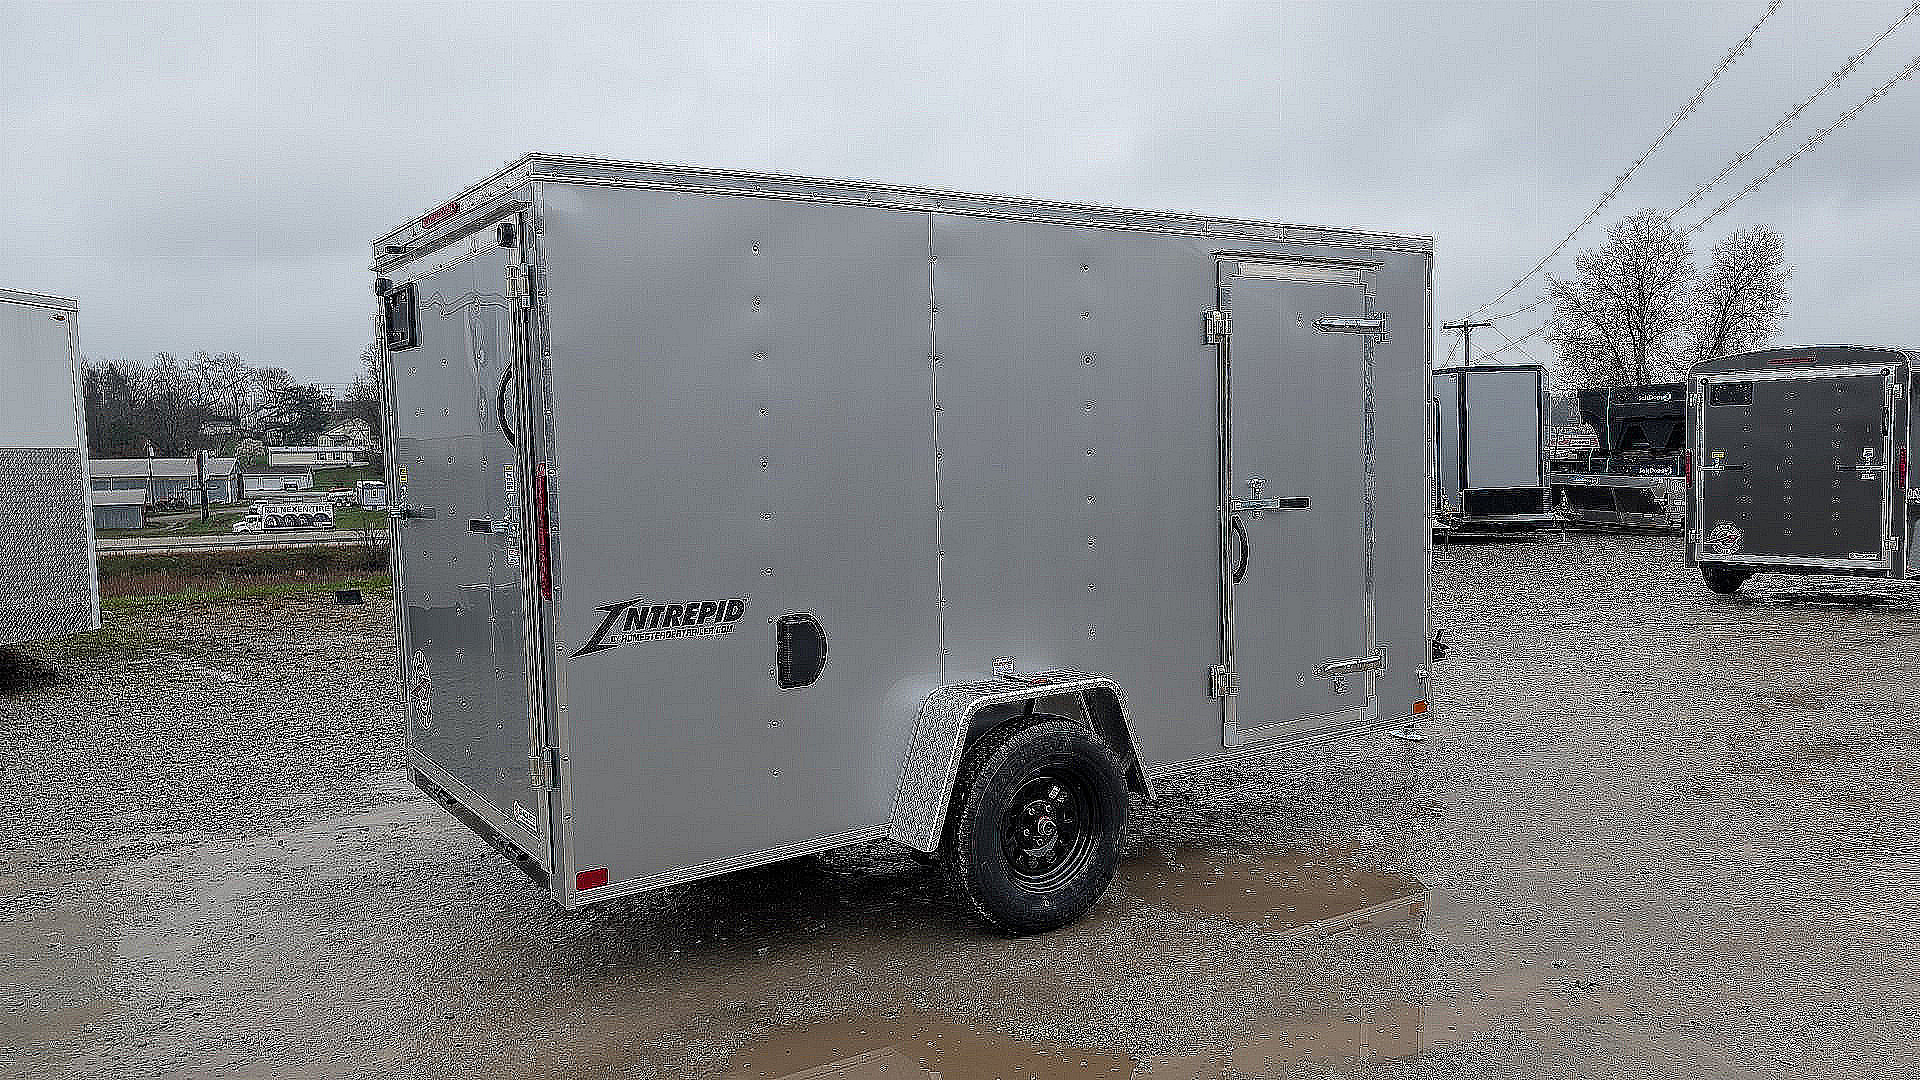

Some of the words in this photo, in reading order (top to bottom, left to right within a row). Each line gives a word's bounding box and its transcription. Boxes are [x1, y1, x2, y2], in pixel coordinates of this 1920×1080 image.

[280, 505, 309, 513] NEXEN
[311, 505, 331, 513] TIRE
[568, 597, 746, 659] INTREPID
